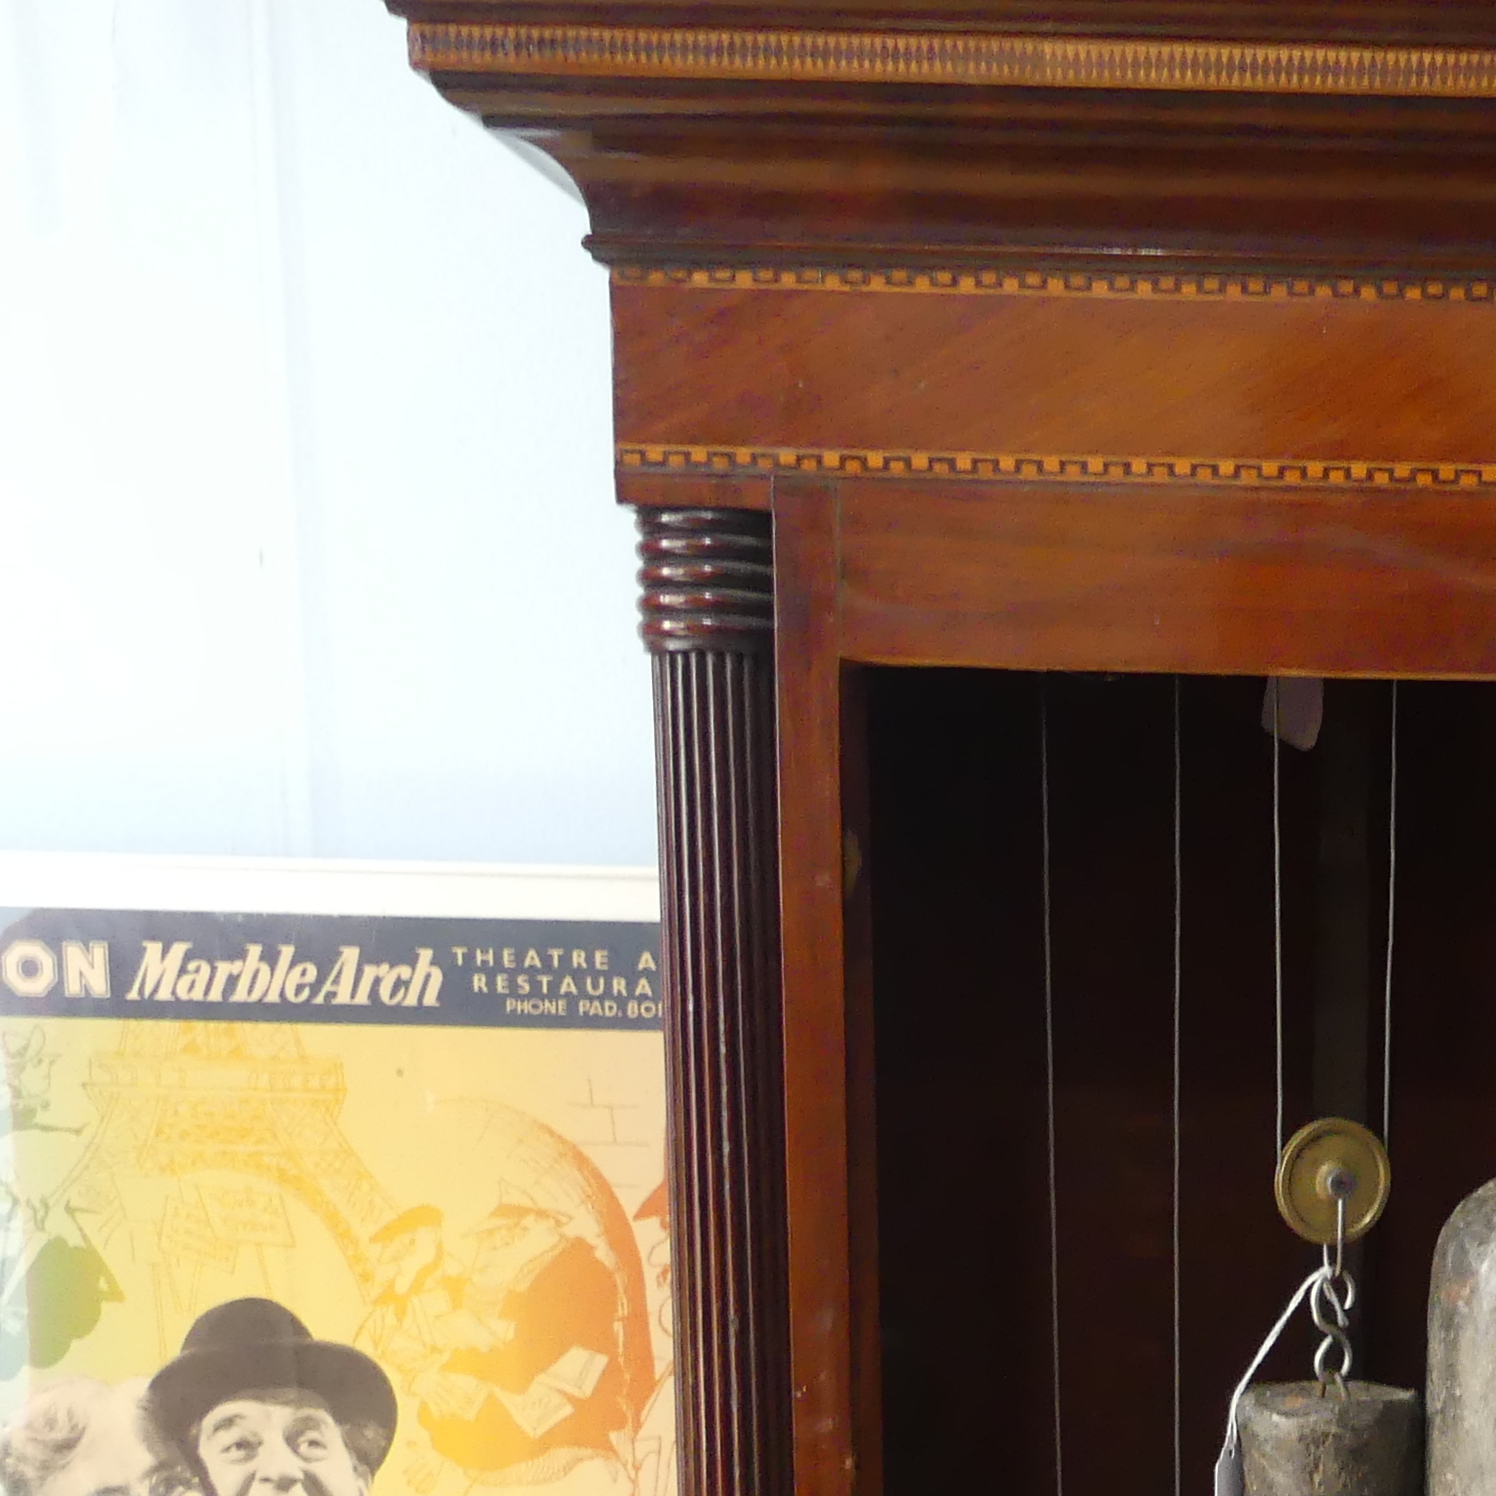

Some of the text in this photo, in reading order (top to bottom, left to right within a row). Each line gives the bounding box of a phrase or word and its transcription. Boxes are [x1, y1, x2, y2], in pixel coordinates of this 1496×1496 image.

[451, 946, 609, 970] THEATRE
[124, 940, 318, 1004] Marble
[311, 945, 444, 1007] Arch
[472, 973, 653, 997] RESTAURA
[505, 998, 567, 1016] PHONE
